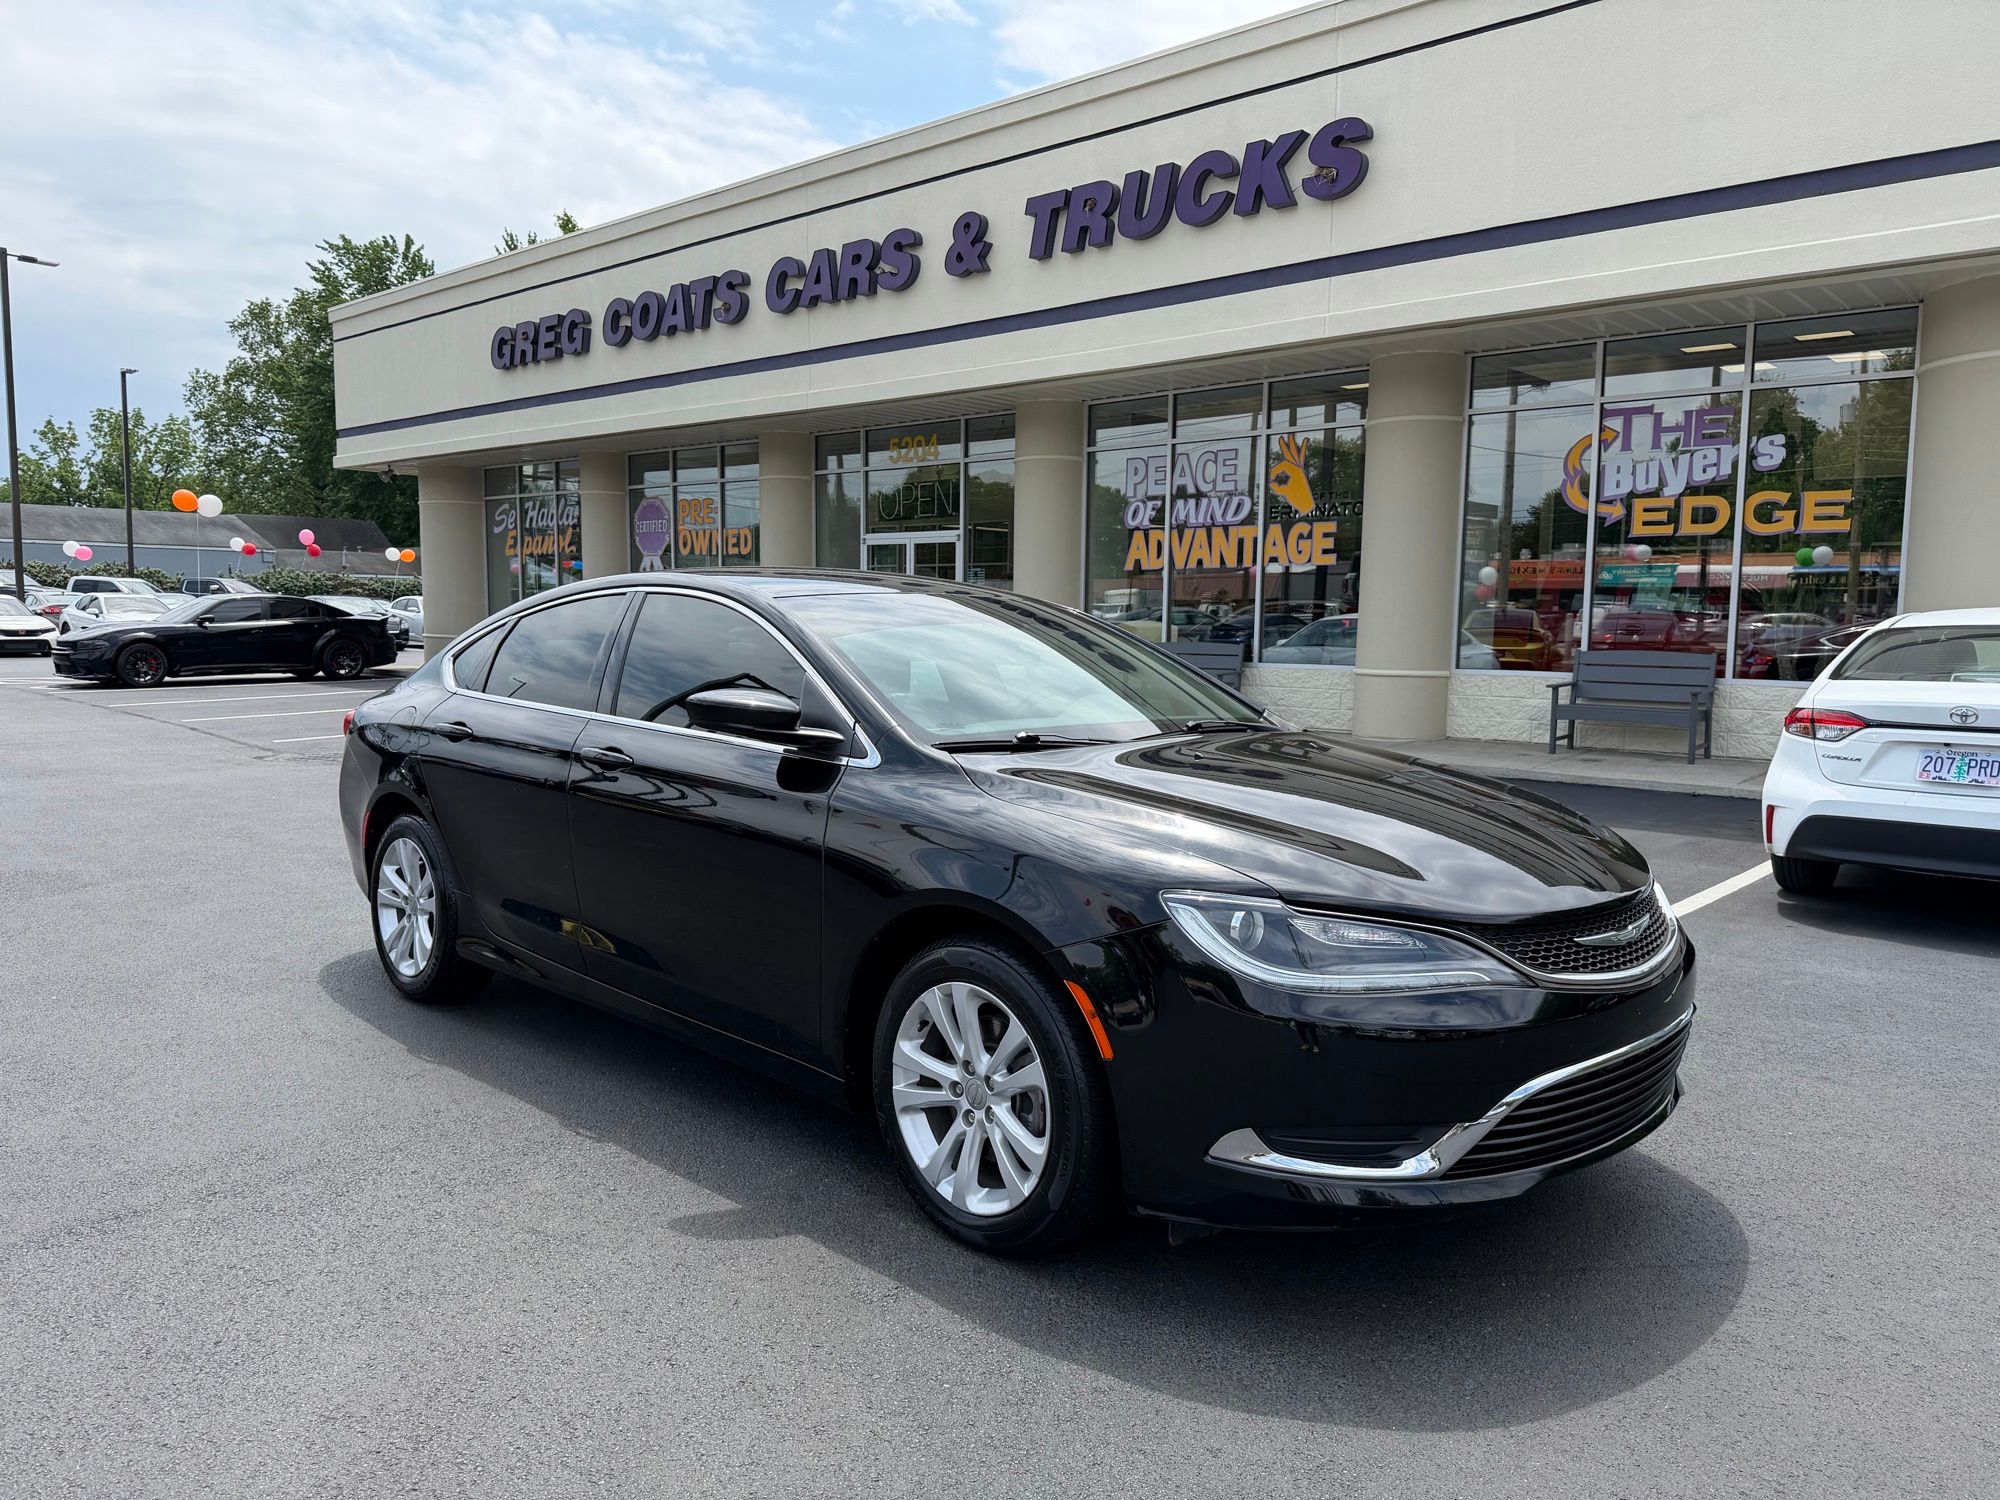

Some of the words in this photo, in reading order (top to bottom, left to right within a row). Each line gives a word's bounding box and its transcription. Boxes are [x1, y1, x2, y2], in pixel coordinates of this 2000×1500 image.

[491, 309, 591, 369] GREG
[603, 270, 750, 347] COATS
[766, 228, 923, 314] CARS
[944, 211, 993, 278] &
[1024, 116, 1374, 261] TRUCKS
[1601, 404, 1735, 453] THE
[888, 433, 941, 464] 5204
[1124, 448, 1239, 497] PEACE
[1598, 433, 1786, 498] Buyer's
[678, 498, 718, 526] PRE-
[879, 481, 952, 520] OPEN
[1124, 499, 1164, 529] OF
[1172, 496, 1252, 528] MIND
[1628, 489, 1853, 538] EDGE
[493, 503, 517, 534] Se
[635, 520, 668, 533] CERTIFIED
[678, 528, 752, 556] OWNED
[1124, 521, 1338, 571] ADVANTAGE
[1922, 755, 1957, 775] 207
[1966, 758, 2000, 778] PRD
[1946, 749, 1979, 758] Oregon
